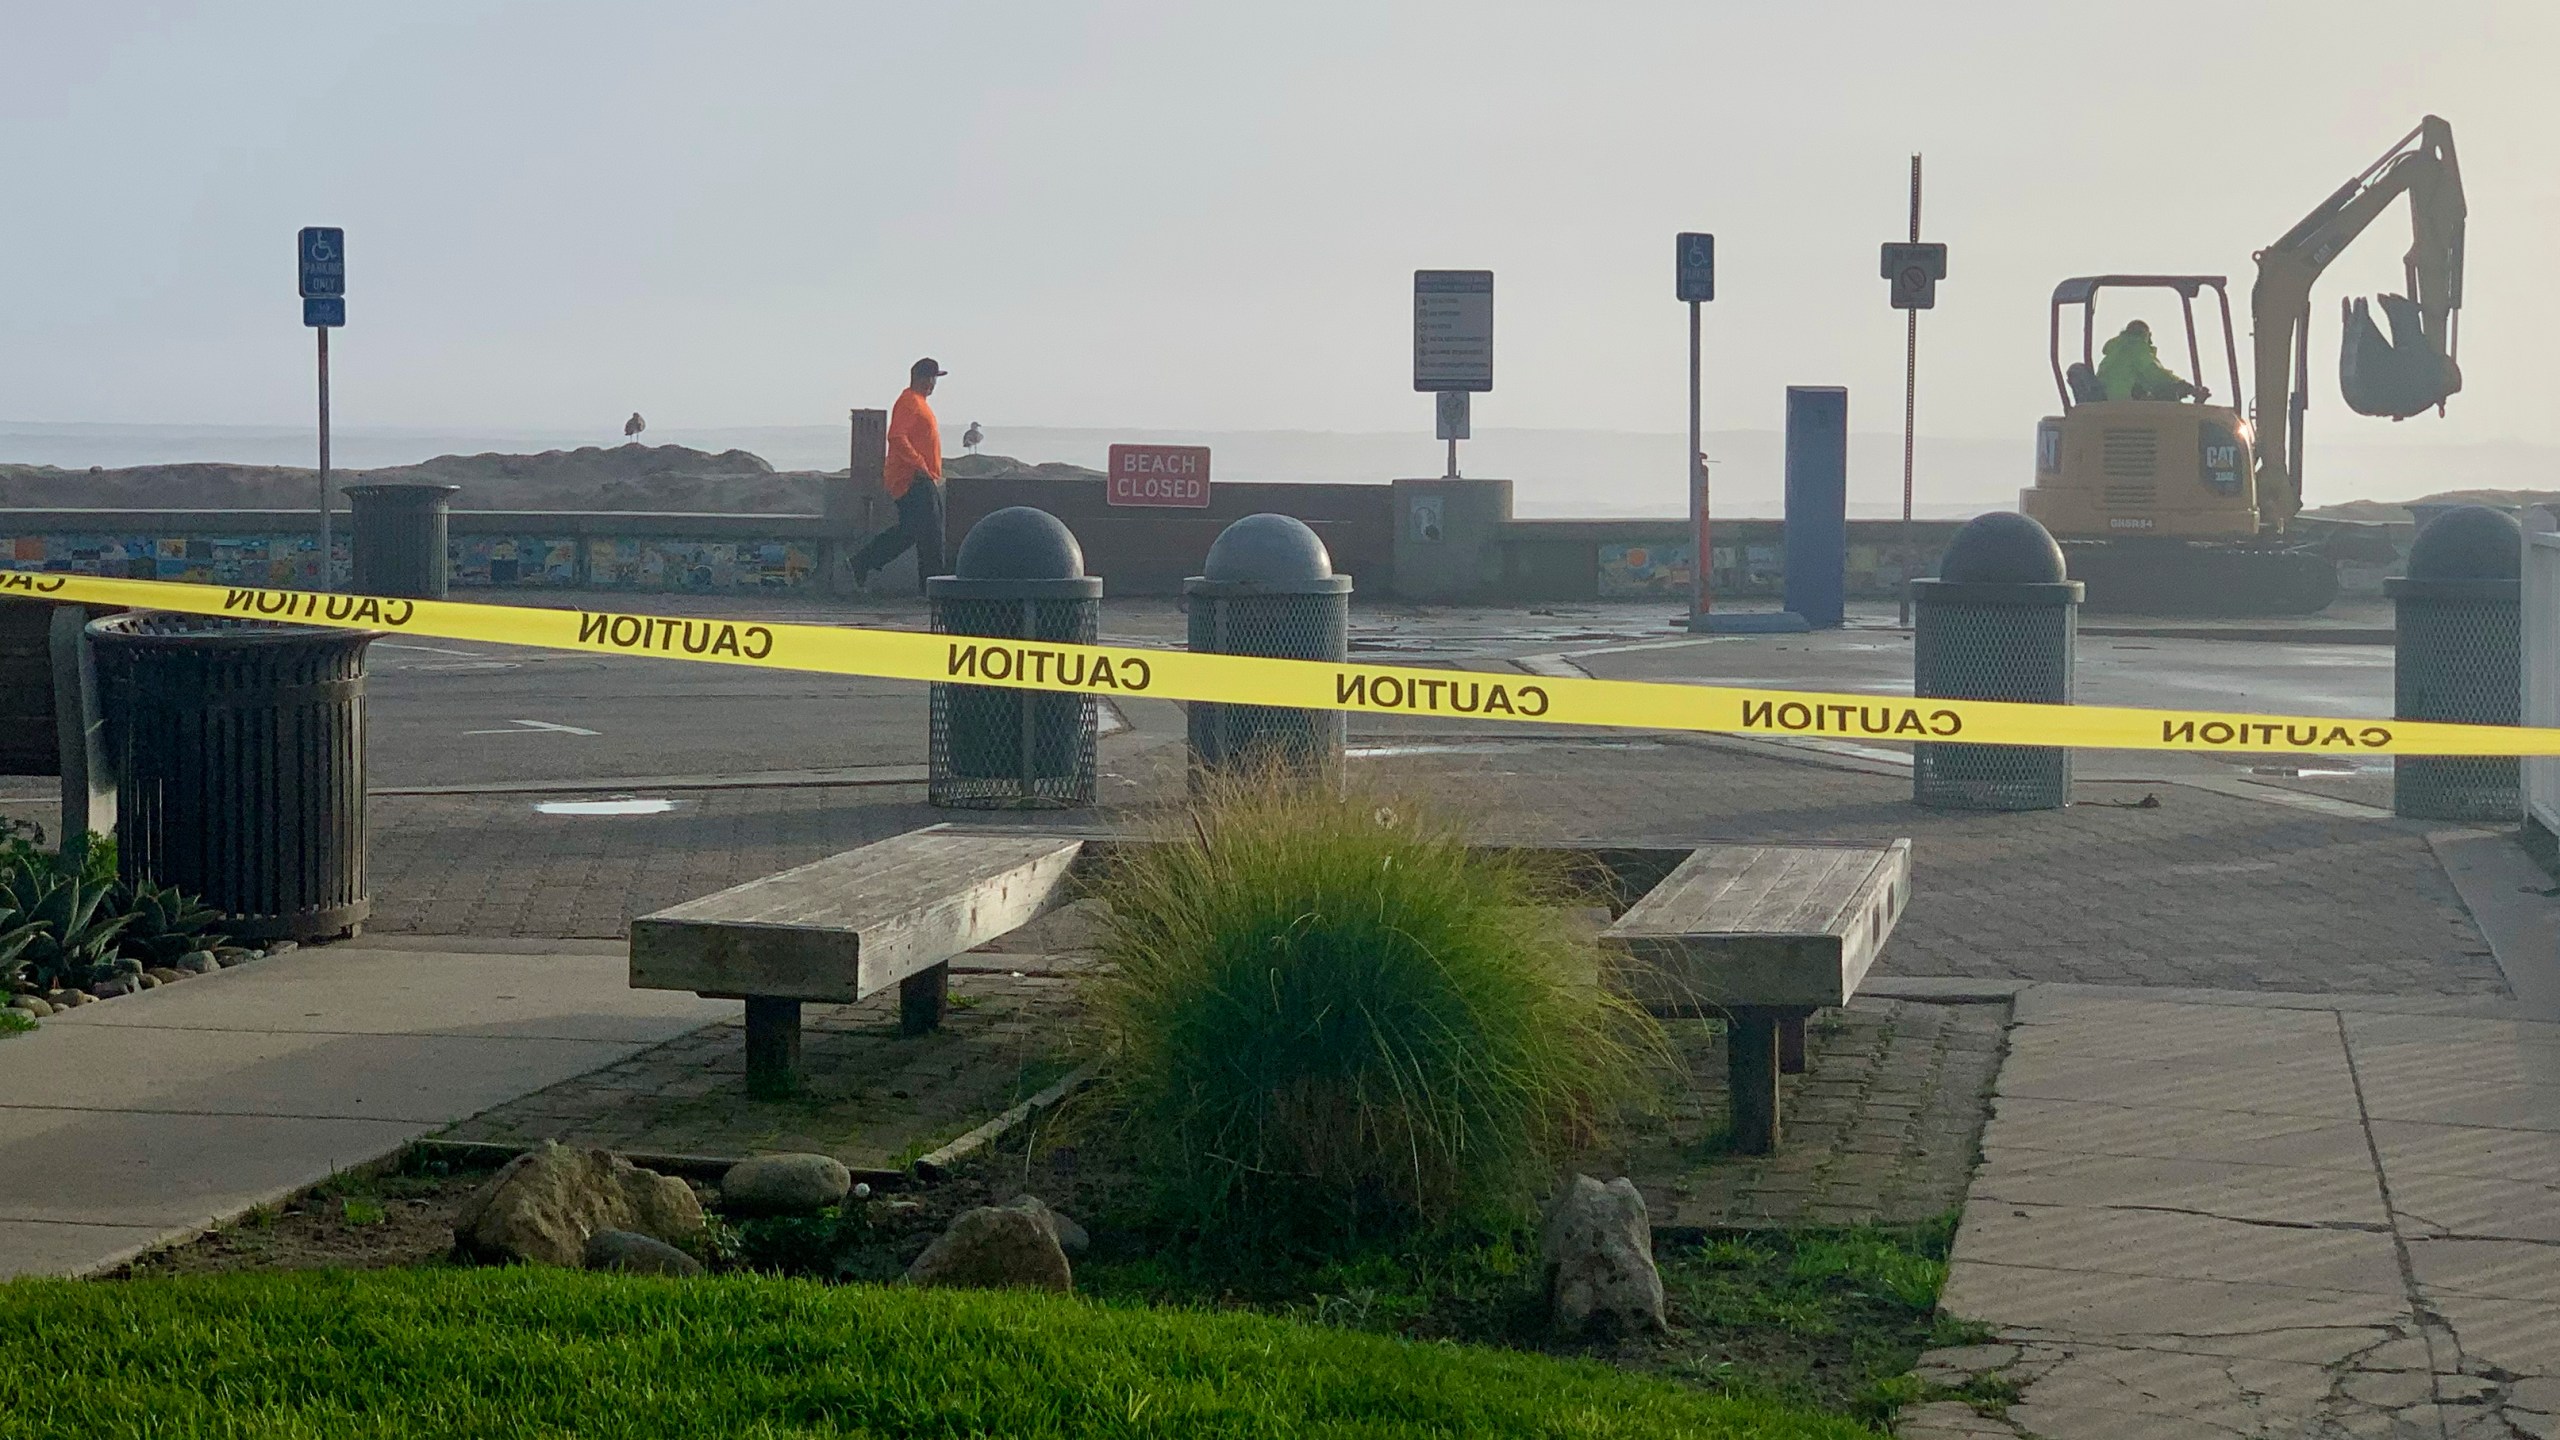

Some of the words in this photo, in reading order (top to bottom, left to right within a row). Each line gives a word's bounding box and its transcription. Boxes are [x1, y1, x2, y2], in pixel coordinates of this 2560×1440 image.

[313, 278, 336, 290] ONLY
[1124, 454, 1196, 473] BEACH
[2206, 446, 2236, 468] CAT
[1117, 478, 1201, 498] CLOSED
